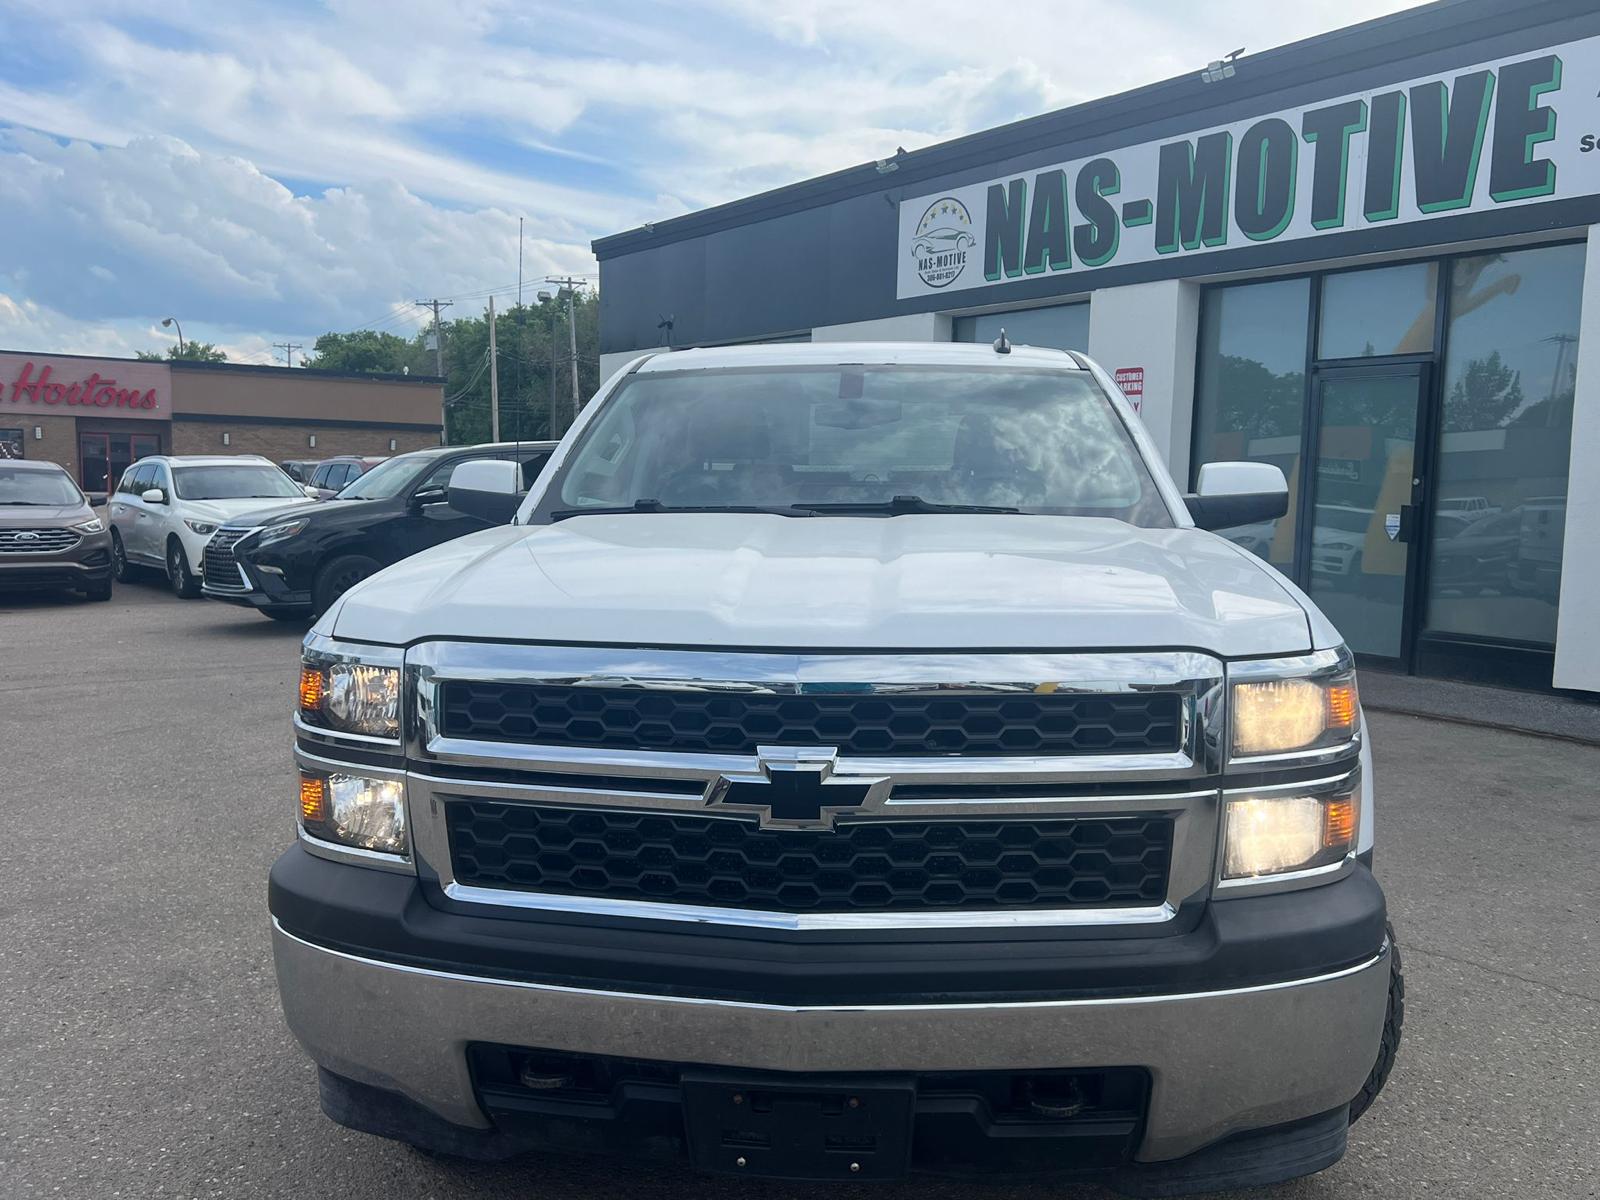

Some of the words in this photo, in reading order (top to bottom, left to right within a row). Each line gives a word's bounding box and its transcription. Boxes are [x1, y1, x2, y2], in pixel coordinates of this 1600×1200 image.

[984, 54, 1563, 282] NAS-MOTIVE
[918, 251, 967, 271] NAS-MOTIVE
[11, 362, 157, 409] Hortons
[1116, 372, 1143, 382] CUSTOMER
[1120, 381, 1142, 391] ARKING
